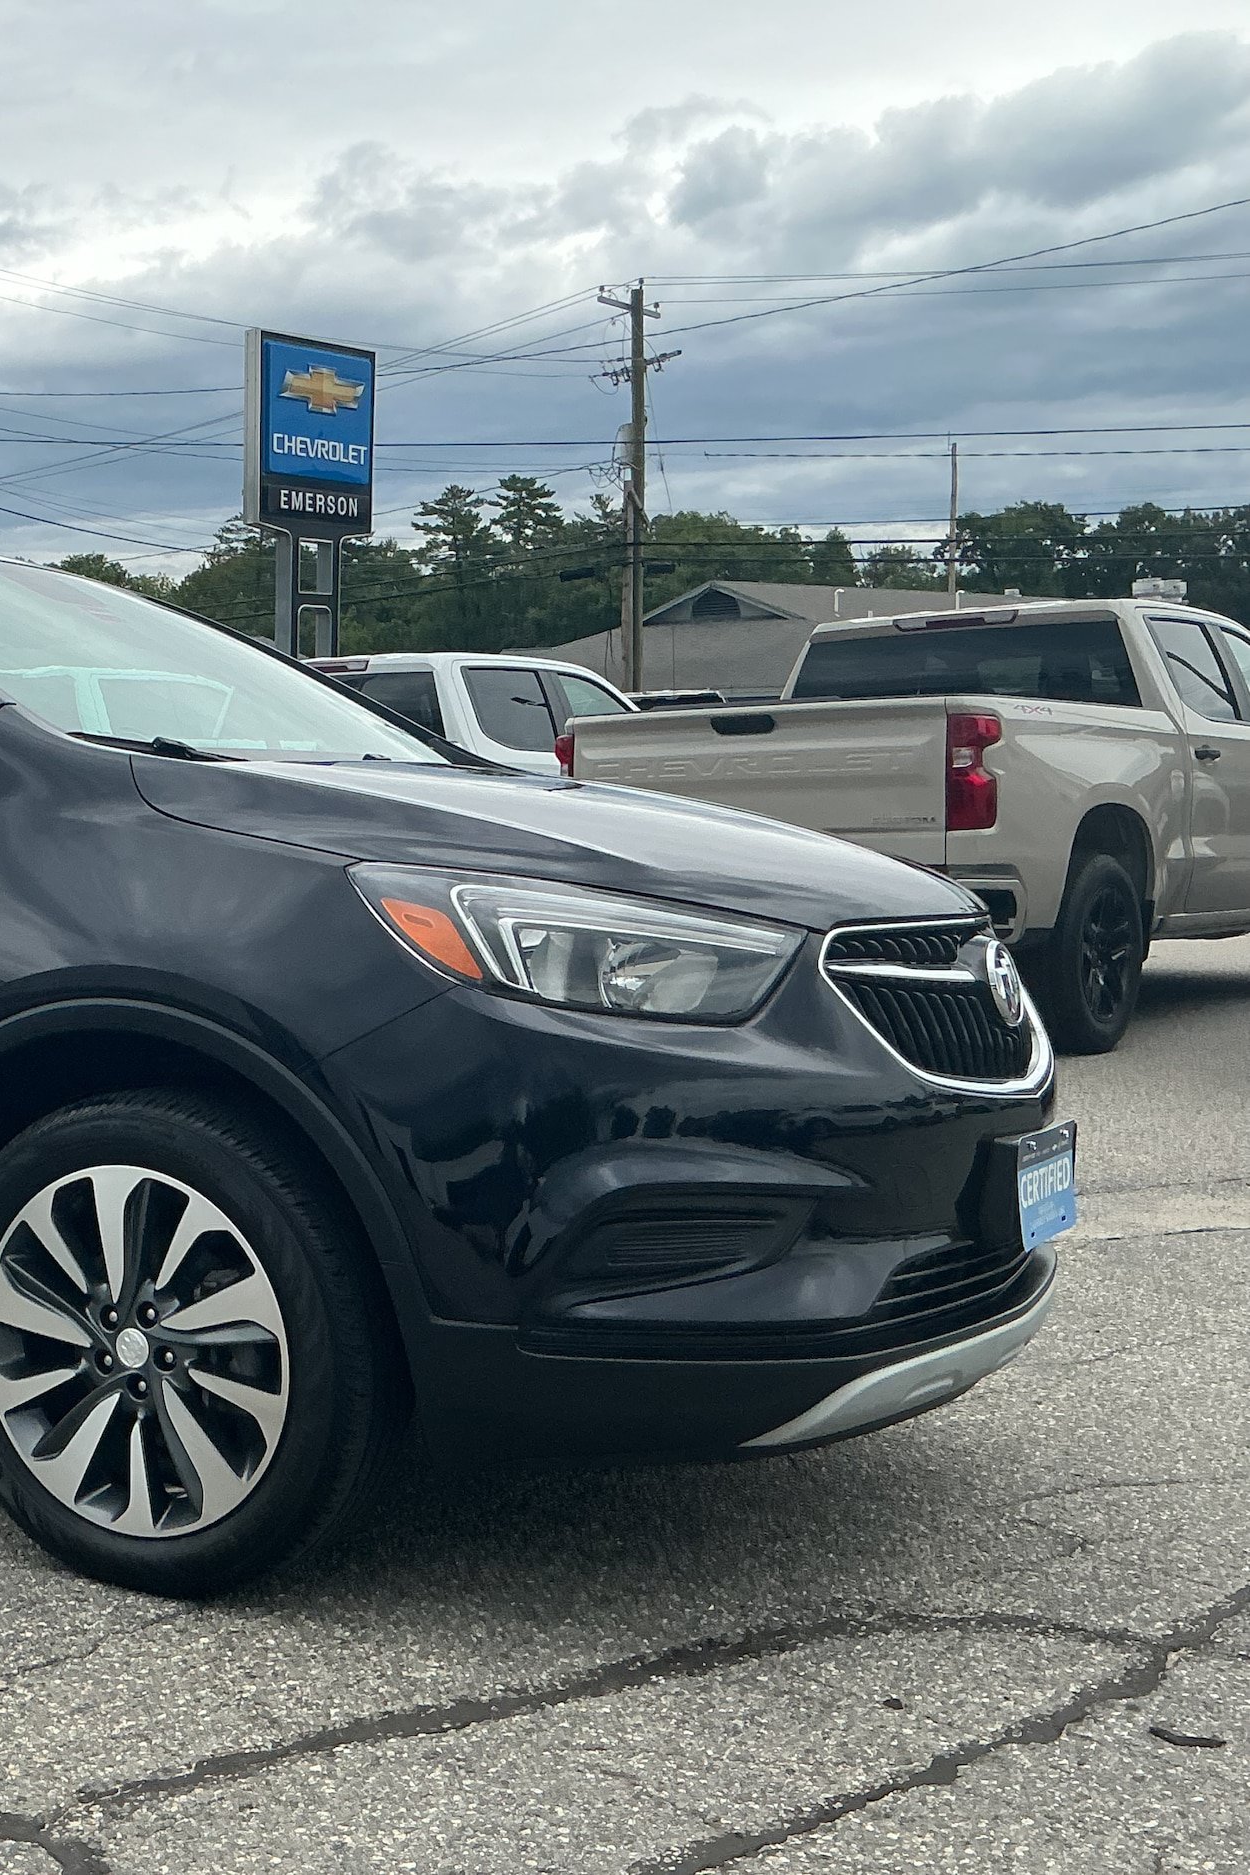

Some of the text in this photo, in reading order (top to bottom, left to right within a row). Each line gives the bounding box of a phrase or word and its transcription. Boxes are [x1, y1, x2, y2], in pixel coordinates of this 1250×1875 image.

[273, 433, 367, 464] CHEVROLET
[280, 489, 358, 517] EMERSON
[594, 751, 914, 781] CHEVROLET
[1021, 1157, 1070, 1209] CERTIFIED
